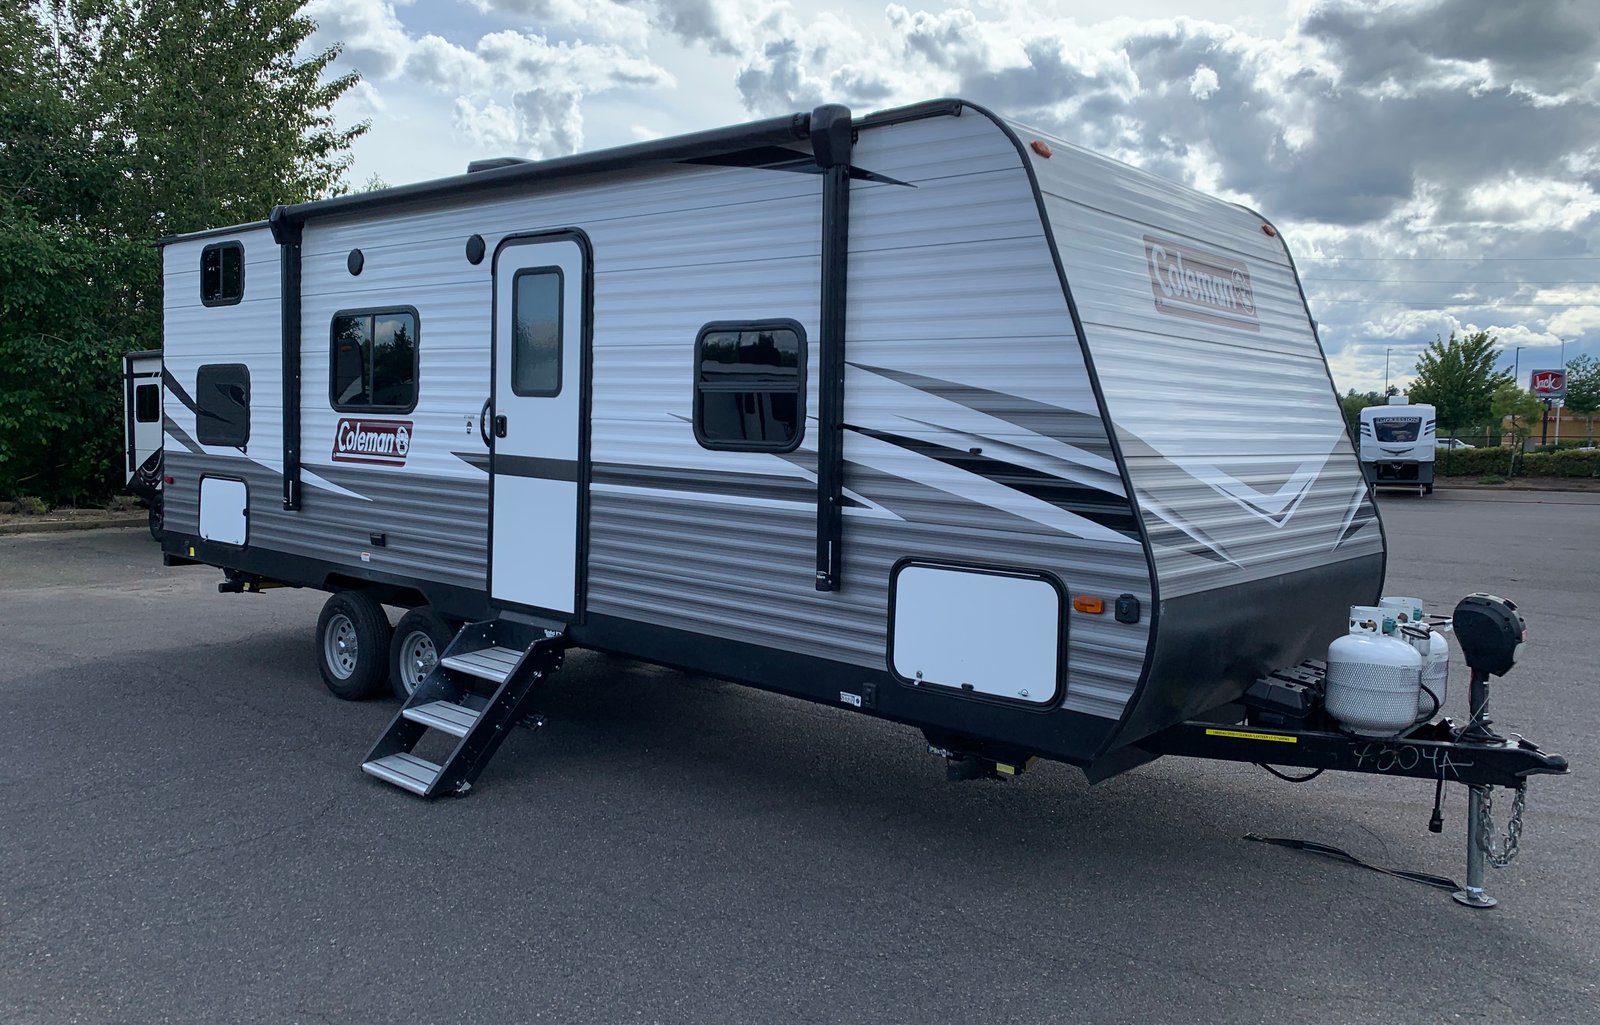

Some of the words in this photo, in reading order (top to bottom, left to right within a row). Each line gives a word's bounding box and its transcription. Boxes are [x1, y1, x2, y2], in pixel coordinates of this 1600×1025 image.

[1151, 243, 1238, 309] Coleman
[1534, 373, 1562, 390] Jack
[338, 420, 395, 453] Coleman
